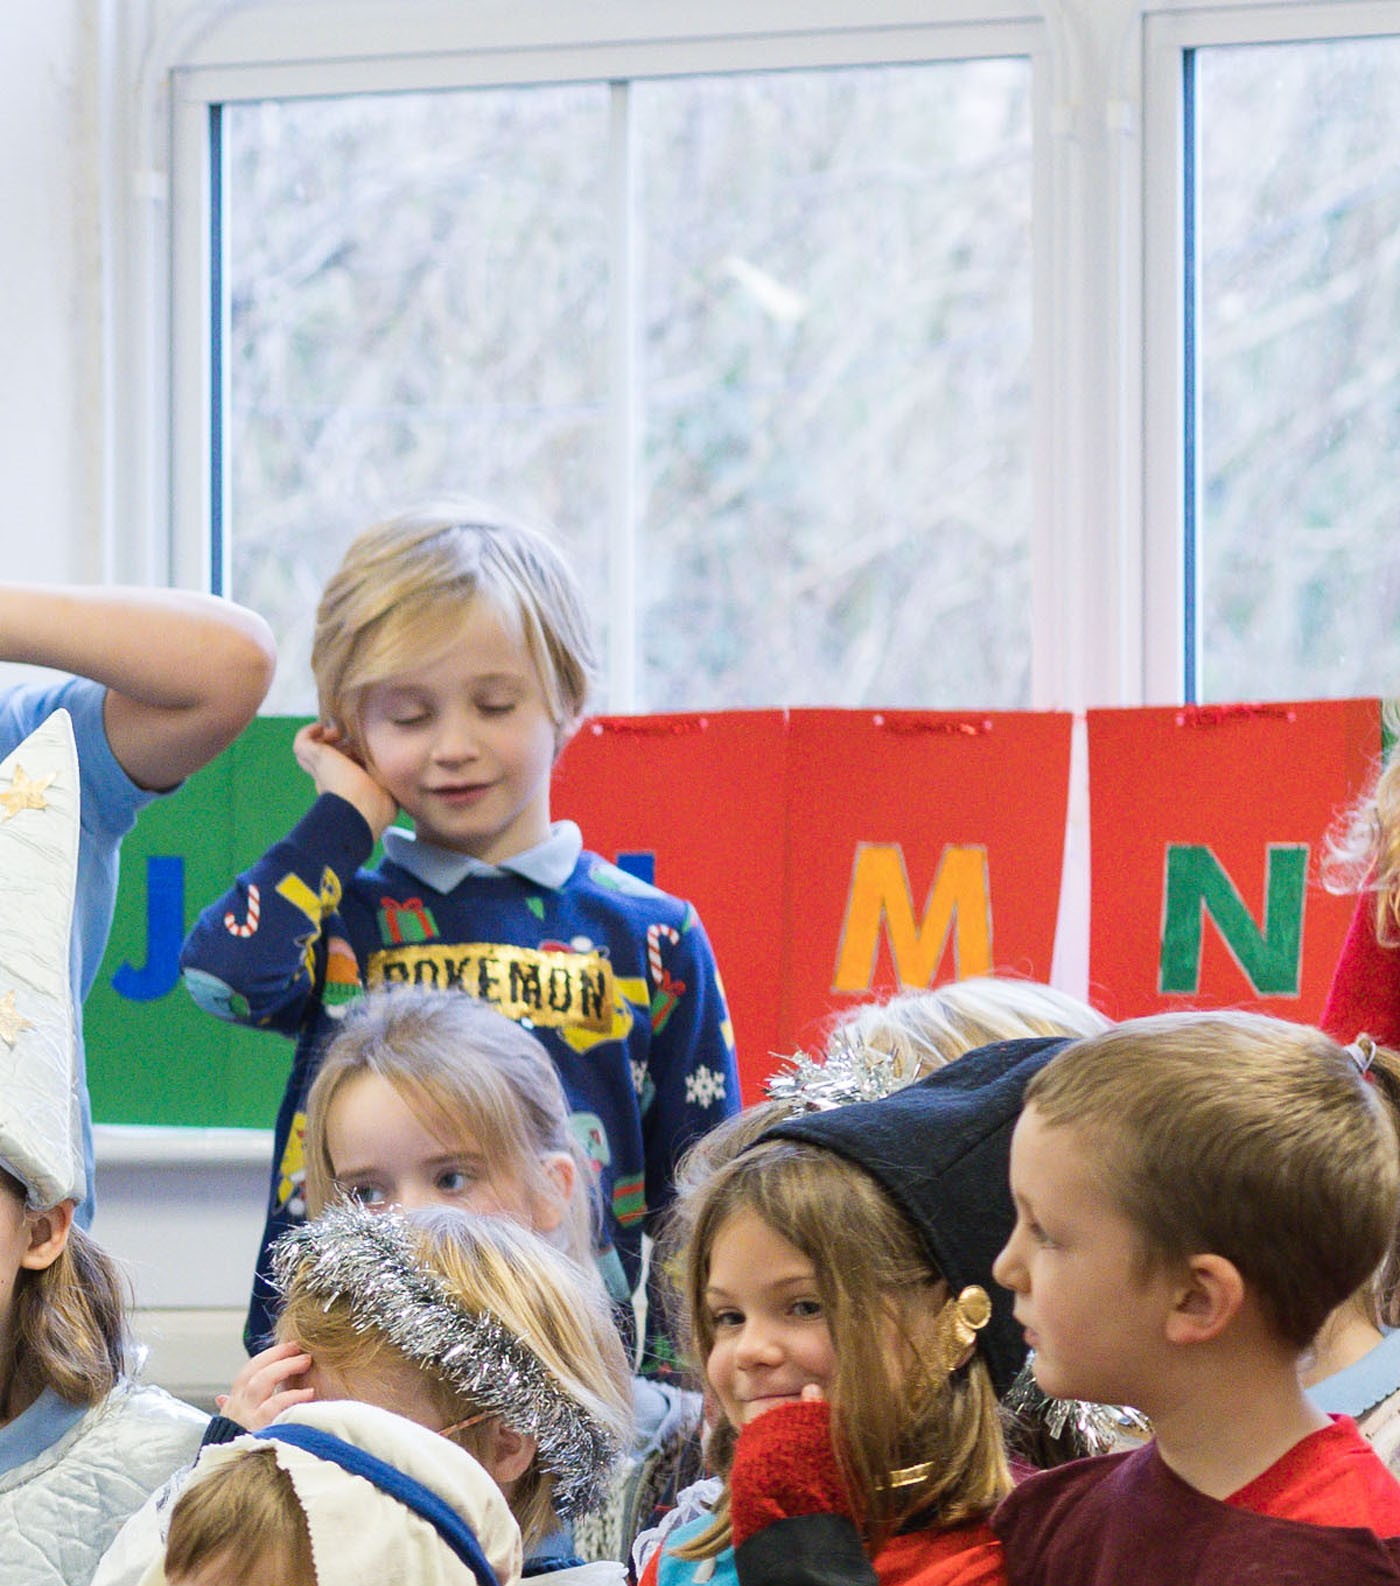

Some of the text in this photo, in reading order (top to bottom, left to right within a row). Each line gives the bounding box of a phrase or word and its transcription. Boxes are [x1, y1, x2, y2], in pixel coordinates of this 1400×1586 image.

[111, 856, 184, 1001] J
[831, 842, 993, 994] M
[1157, 842, 1310, 999] N
